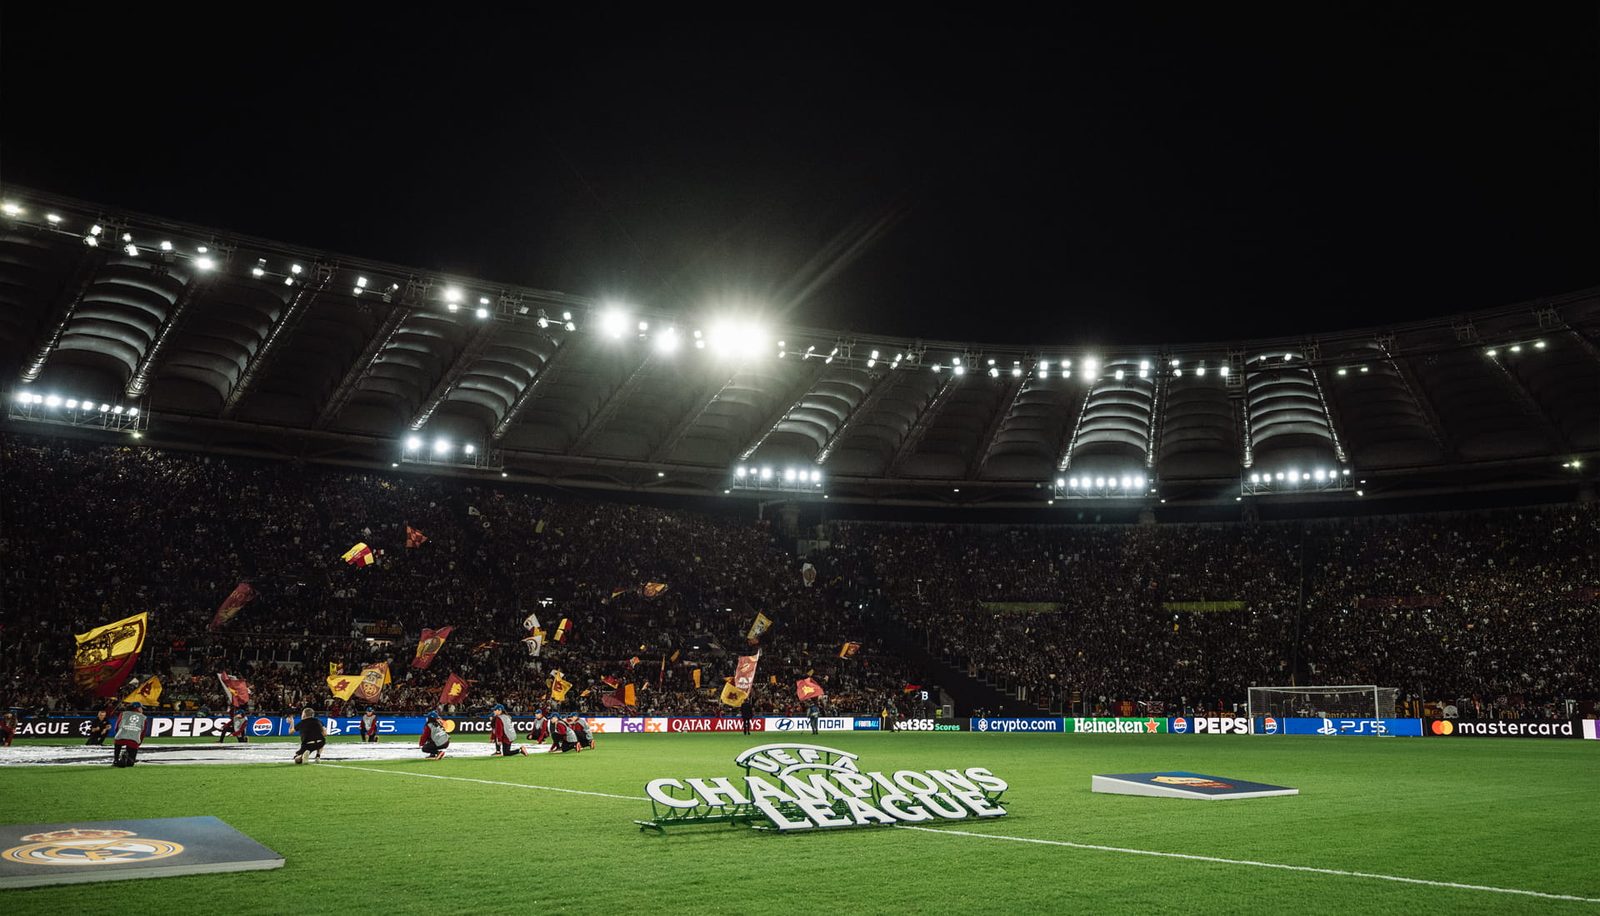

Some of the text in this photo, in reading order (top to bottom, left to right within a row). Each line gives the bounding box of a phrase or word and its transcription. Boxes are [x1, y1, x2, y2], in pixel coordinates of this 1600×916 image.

[14, 722, 70, 734] EAGUE
[150, 717, 231, 737] PEPS
[345, 720, 395, 733] P5
[460, 721, 534, 731] masrca
[621, 718, 662, 732] FedEx
[672, 719, 762, 731] QATAR AIRWYS
[797, 719, 844, 729] HYNDAI
[935, 723, 960, 731] Scores
[991, 720, 1056, 732] crypto.com
[1074, 717, 1144, 733] Heineken
[1458, 720, 1573, 736] mastercard
[748, 749, 859, 773] UEFA
[645, 767, 1008, 808] CHAMPIONS
[753, 791, 1007, 830] LEAGUE
